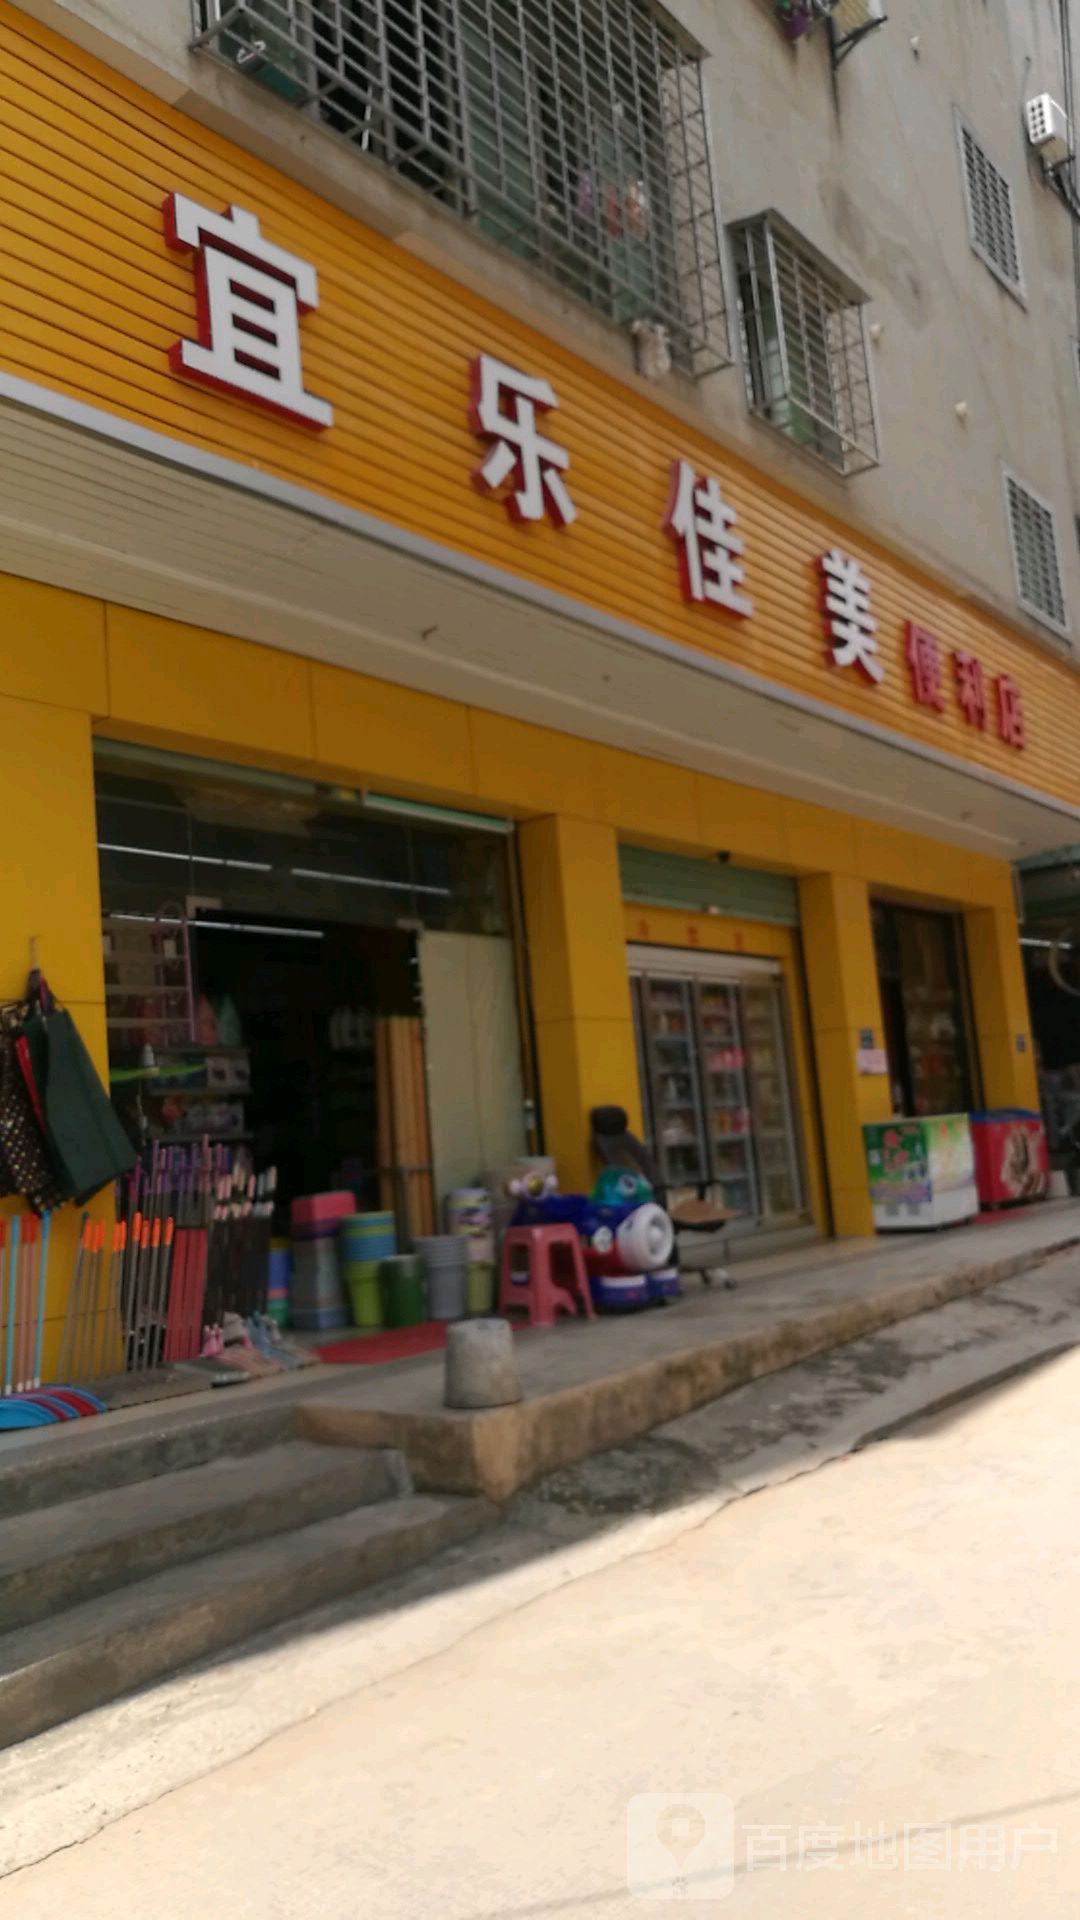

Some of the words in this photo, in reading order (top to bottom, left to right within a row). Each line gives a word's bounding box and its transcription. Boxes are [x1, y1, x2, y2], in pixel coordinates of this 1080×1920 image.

[165, 193, 885, 685] 宜乐佳美
[904, 619, 1025, 751] 便利店
